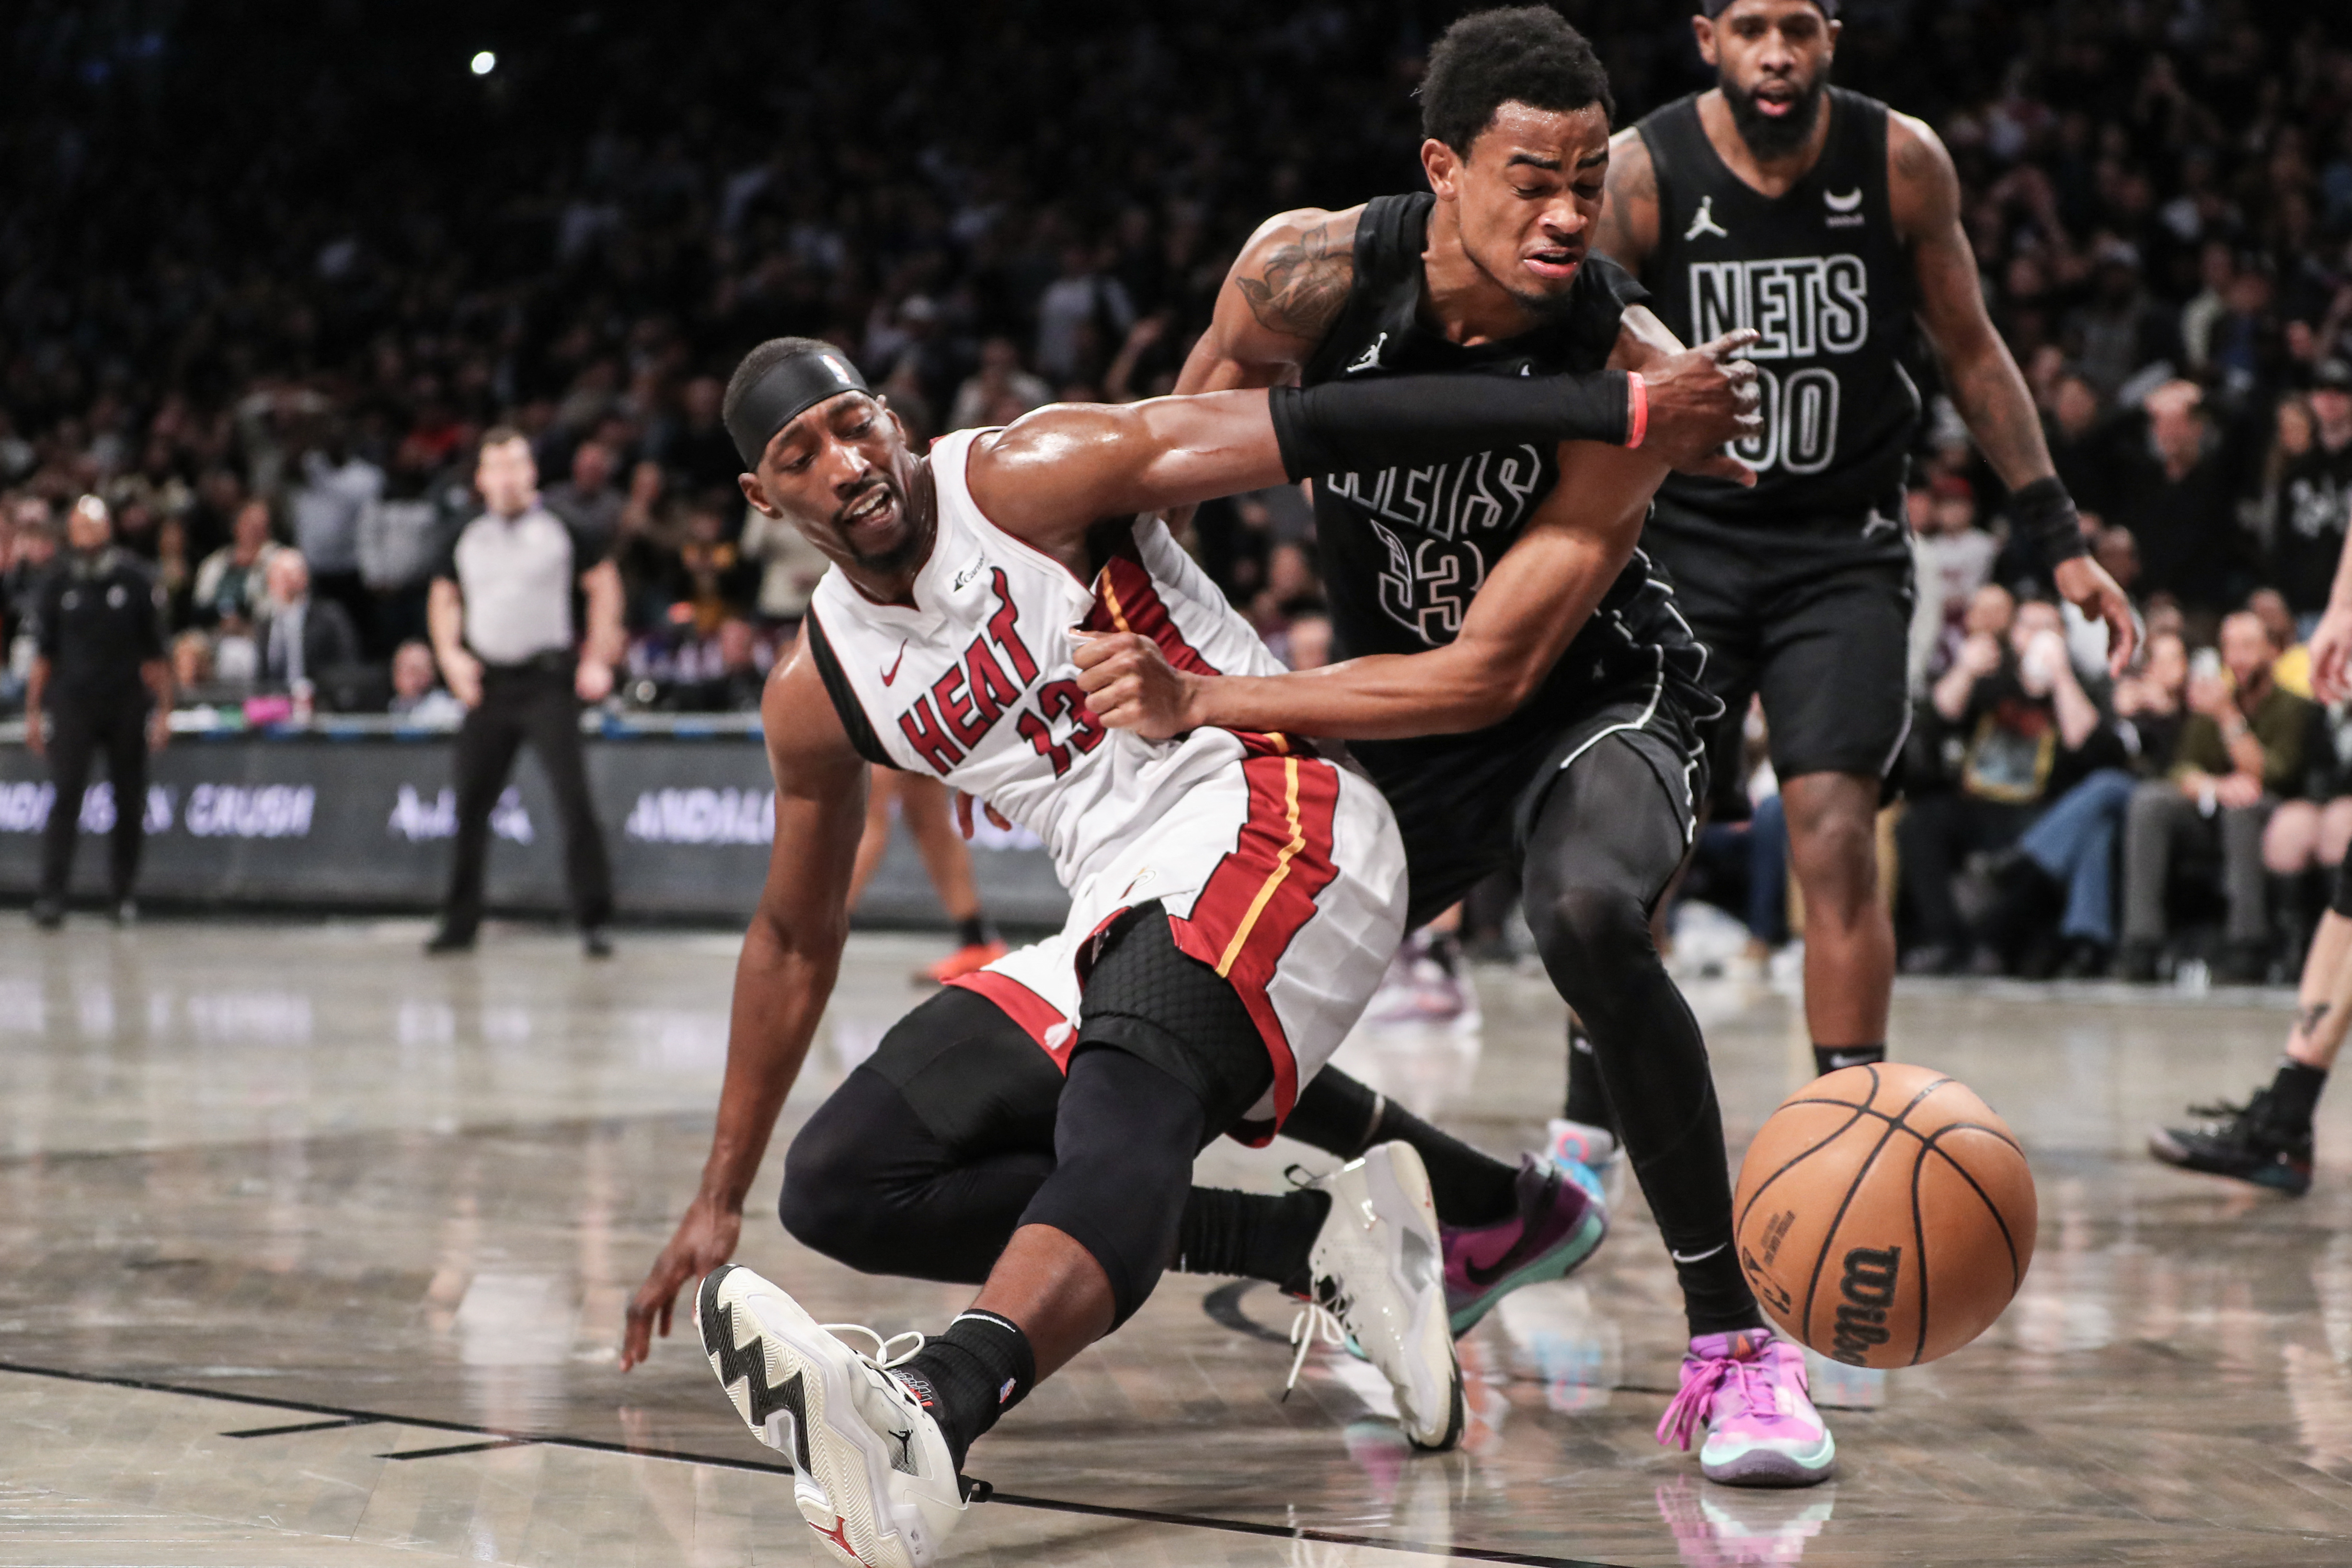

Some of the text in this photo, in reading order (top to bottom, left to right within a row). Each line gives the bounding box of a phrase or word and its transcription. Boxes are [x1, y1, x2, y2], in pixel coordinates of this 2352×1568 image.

[1689, 253, 1868, 358] NETS
[897, 566, 1040, 778] HEAT
[1016, 679, 1107, 779] 13
